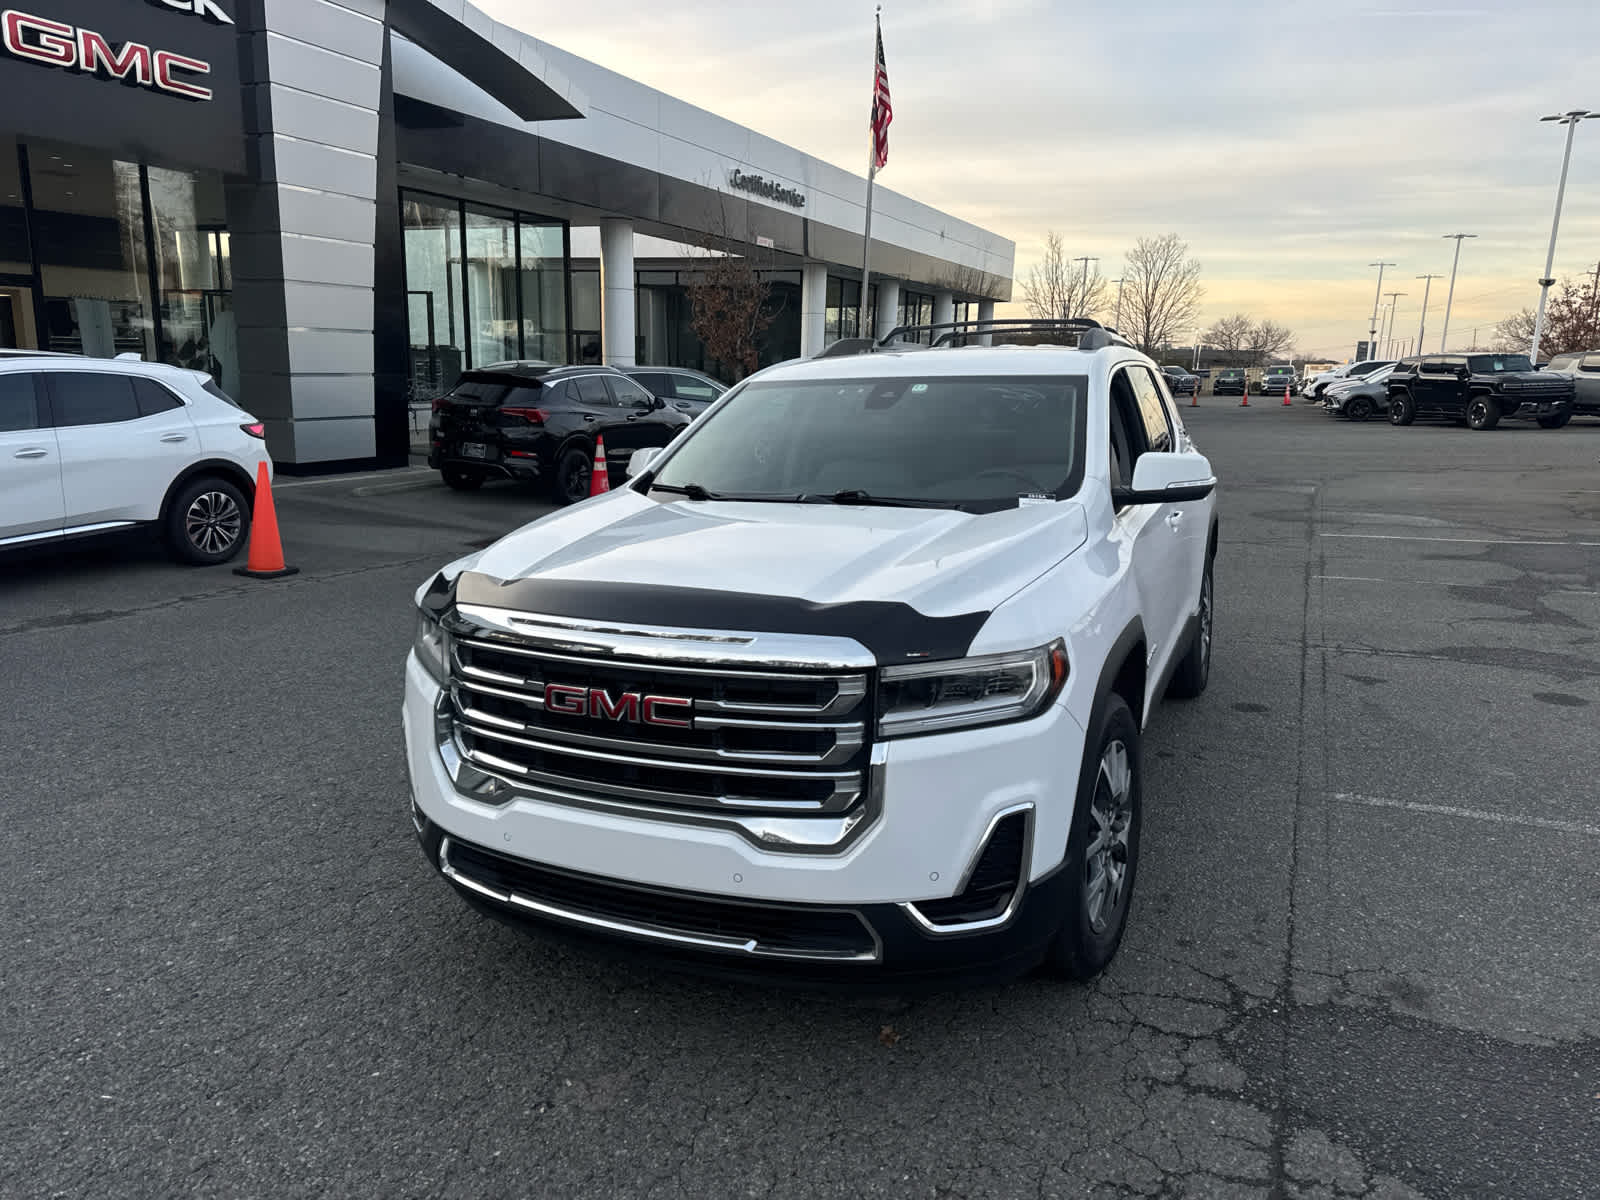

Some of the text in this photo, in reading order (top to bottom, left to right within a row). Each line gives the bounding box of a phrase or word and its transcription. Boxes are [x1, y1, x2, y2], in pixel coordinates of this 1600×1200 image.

[1, 9, 212, 100] GMC
[731, 168, 805, 207] Certified Service
[545, 683, 692, 729] GMC
